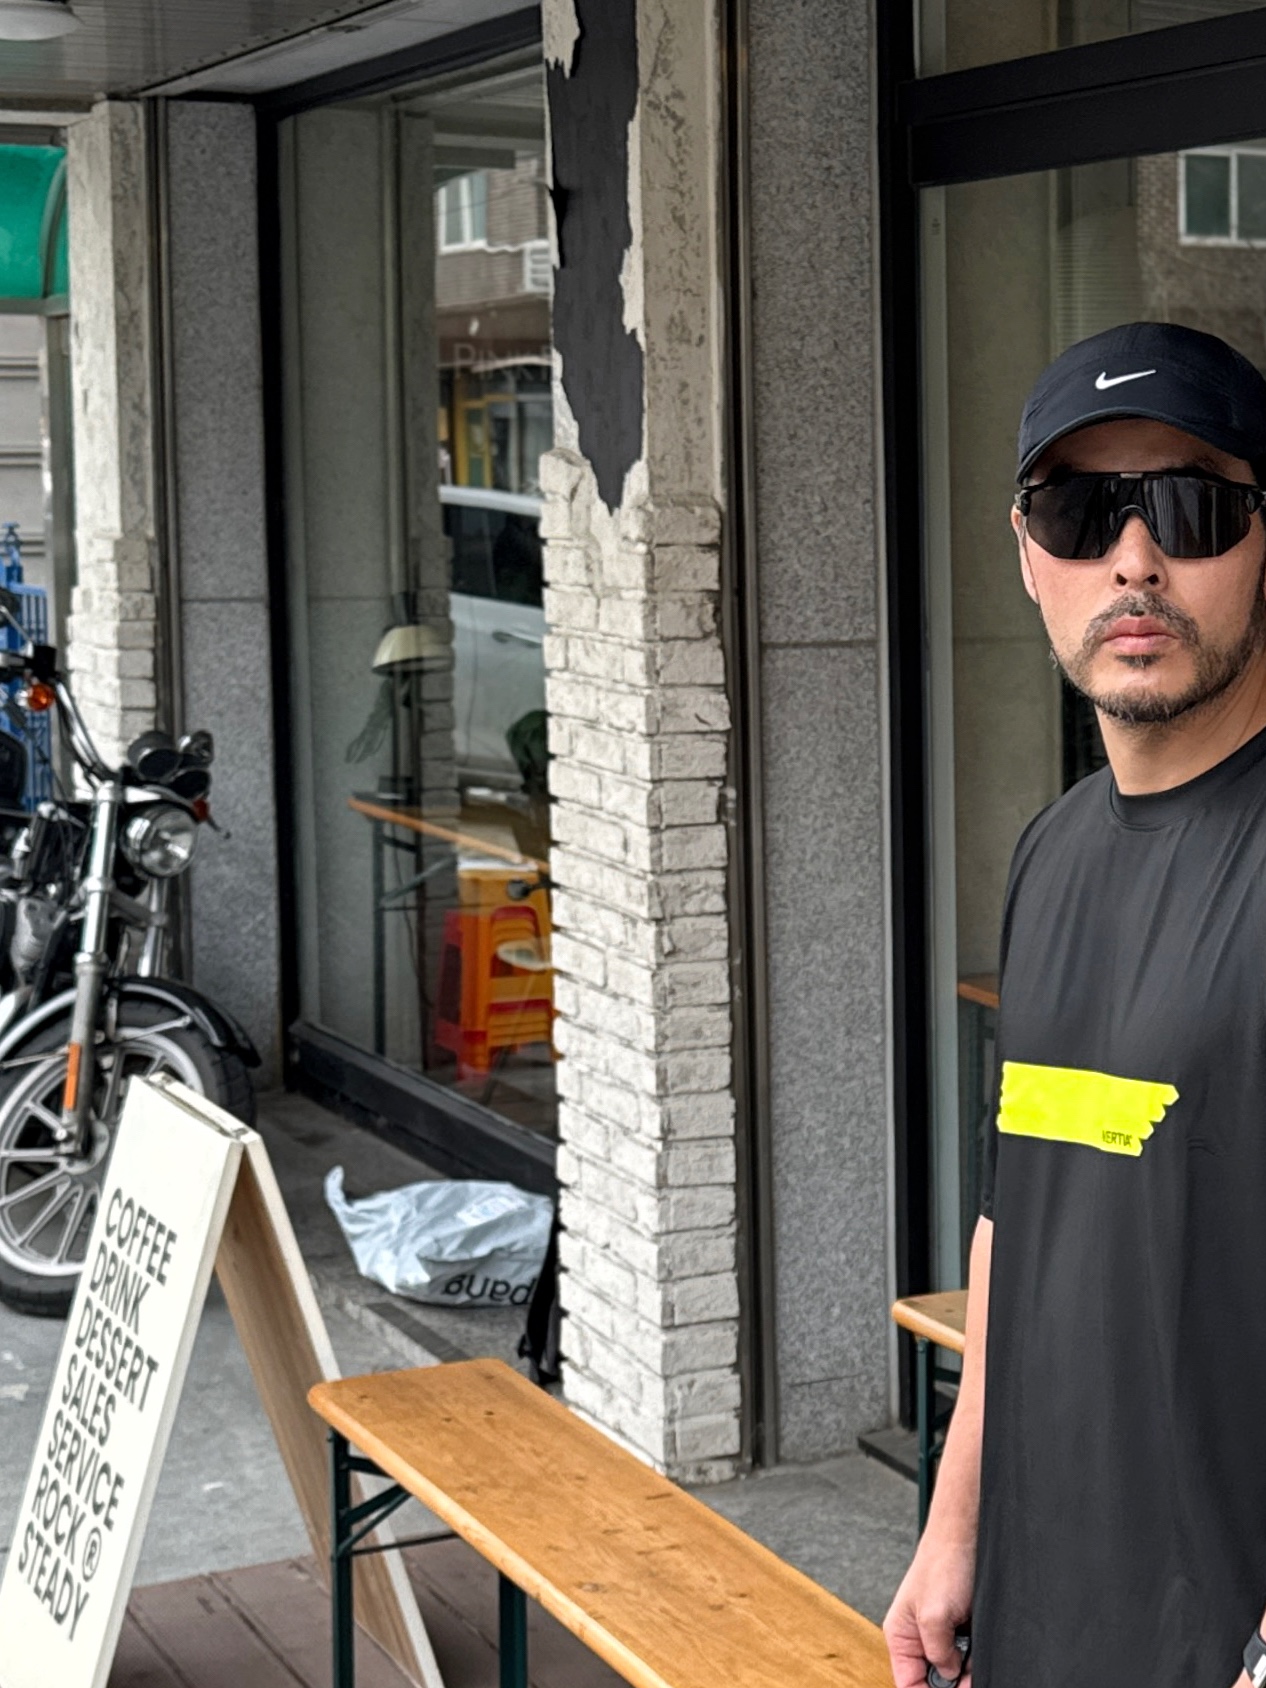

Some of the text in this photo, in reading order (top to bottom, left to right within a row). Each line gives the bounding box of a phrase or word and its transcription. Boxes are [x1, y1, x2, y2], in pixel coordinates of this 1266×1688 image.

[90, 1239, 151, 1335] DRINK
[105, 1187, 178, 1287] COFFEE
[61, 1352, 116, 1447] SALES
[75, 1295, 160, 1412] DESSERT
[31, 1463, 86, 1566] ROCK
[47, 1408, 125, 1532] SERVICE
[18, 1520, 90, 1642] STEADY
